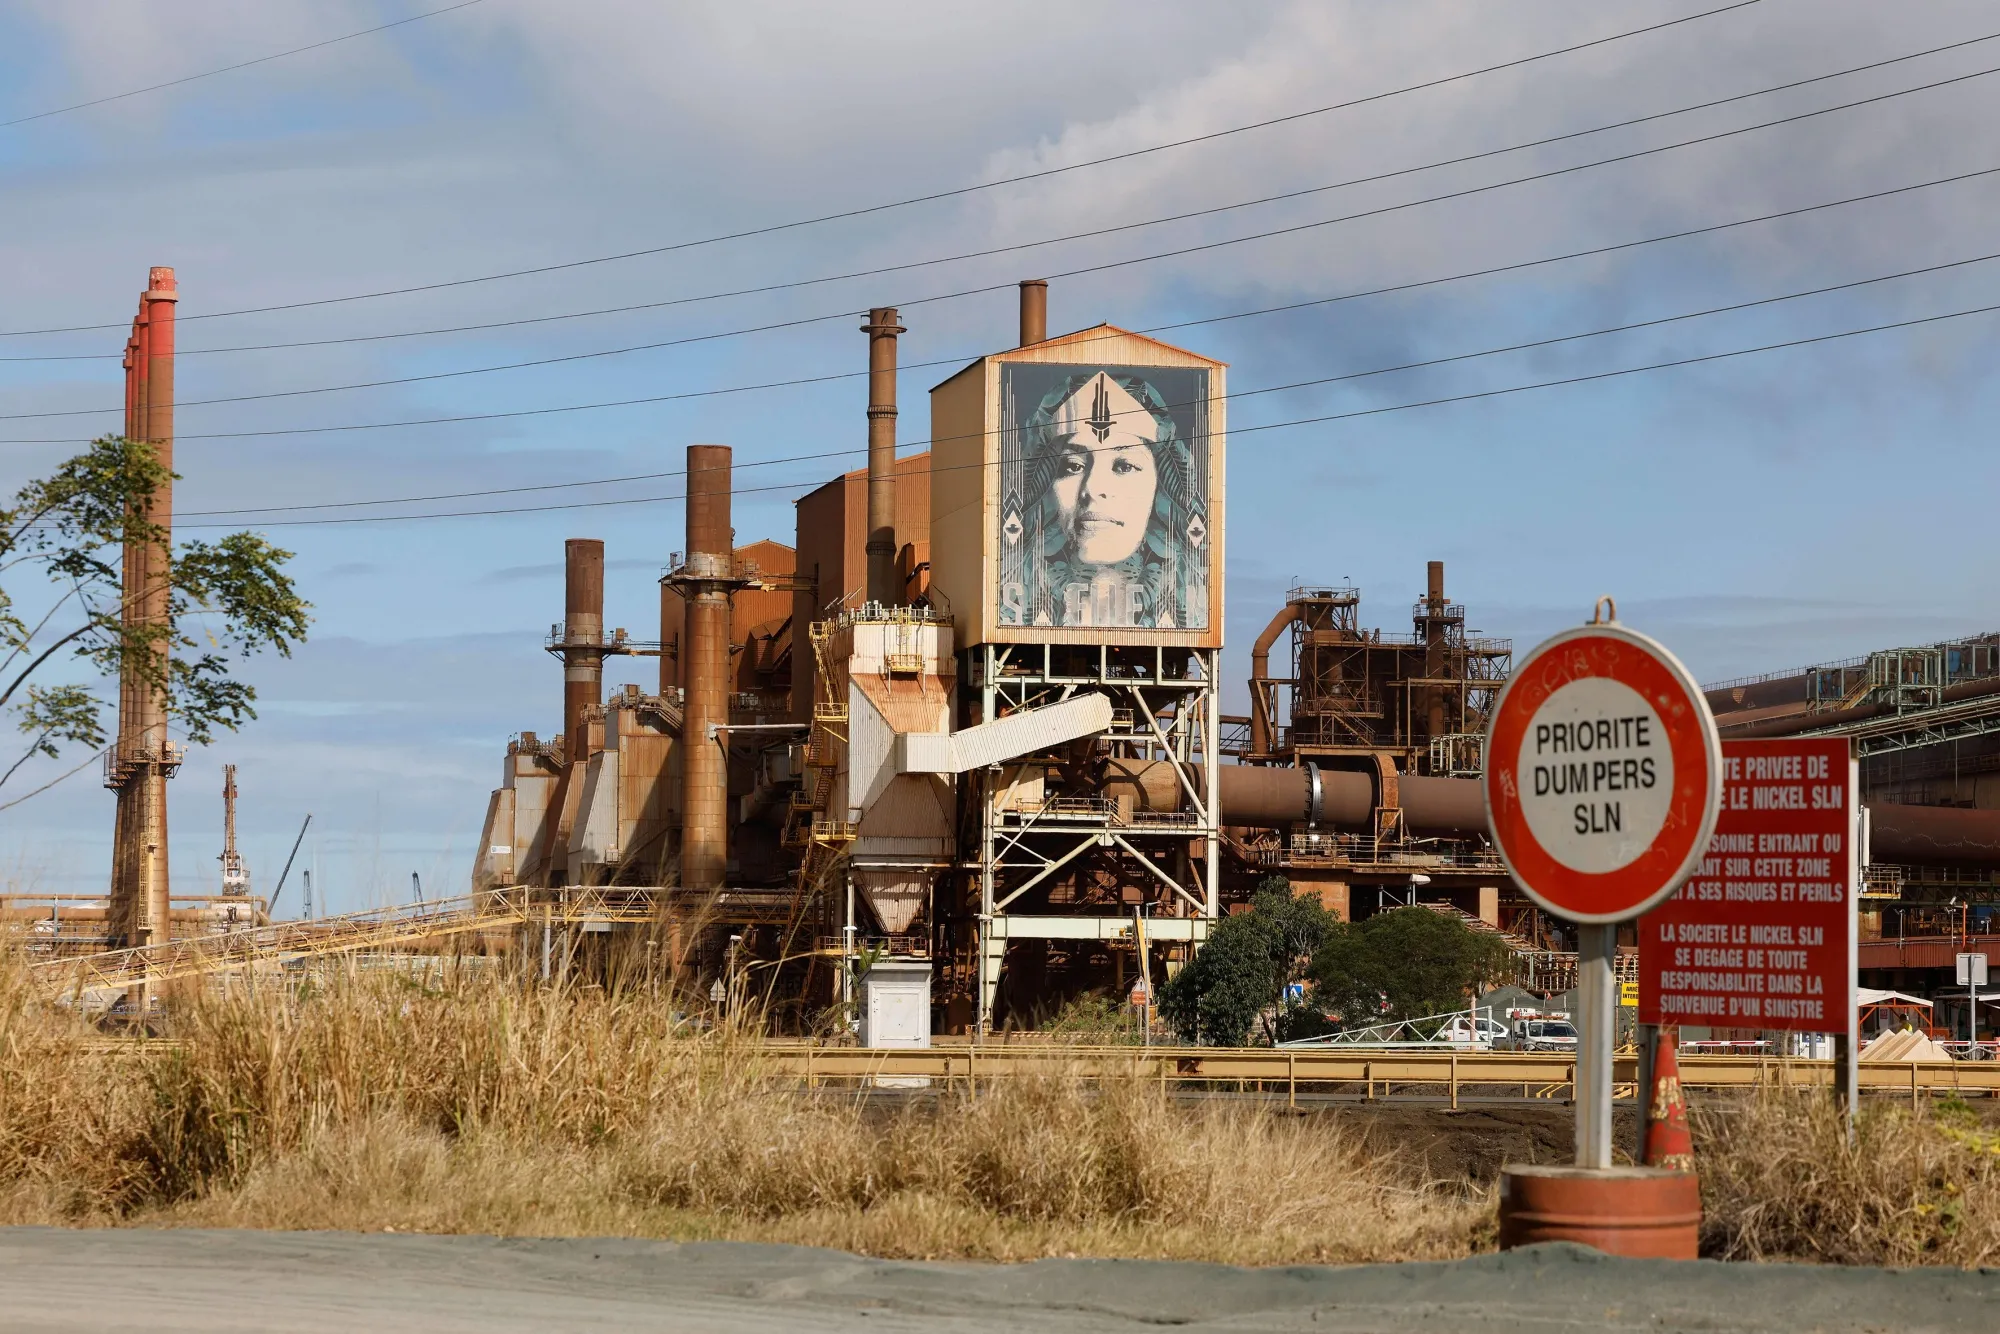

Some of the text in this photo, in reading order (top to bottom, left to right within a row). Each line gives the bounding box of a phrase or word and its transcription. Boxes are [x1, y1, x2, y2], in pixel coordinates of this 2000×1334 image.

[1536, 716, 1651, 754] PRIORITE
[1534, 757, 1656, 796] DUMPERS
[1746, 756, 1802, 780] PRIVEE
[1807, 755, 1829, 779] DE
[1730, 787, 1748, 810] LE
[1753, 786, 1807, 810] NICKEL
[1812, 785, 1842, 809] SLN
[1574, 801, 1621, 834] SLN
[1706, 834, 1841, 853] SONNE ENTRANT OU
[1725, 858, 1750, 877] SUR
[1754, 858, 1792, 877] CETTE
[1796, 859, 1830, 877] ZONE
[1687, 882, 1696, 899] A
[1699, 882, 1722, 900] SES
[1725, 882, 1777, 903] RISQUES
[1781, 882, 1796, 901] ET
[1799, 883, 1843, 902] PERILS
[1660, 924, 1823, 946] LA SOCIETE LE NICKEL SLN
[1675, 948, 1807, 970] SE DEGAGE DE TOUTE
[1661, 971, 1823, 995] RESPONSABILITE DANS LA
[1660, 994, 1823, 1019] SURVENUE D'UN SINISTRE
